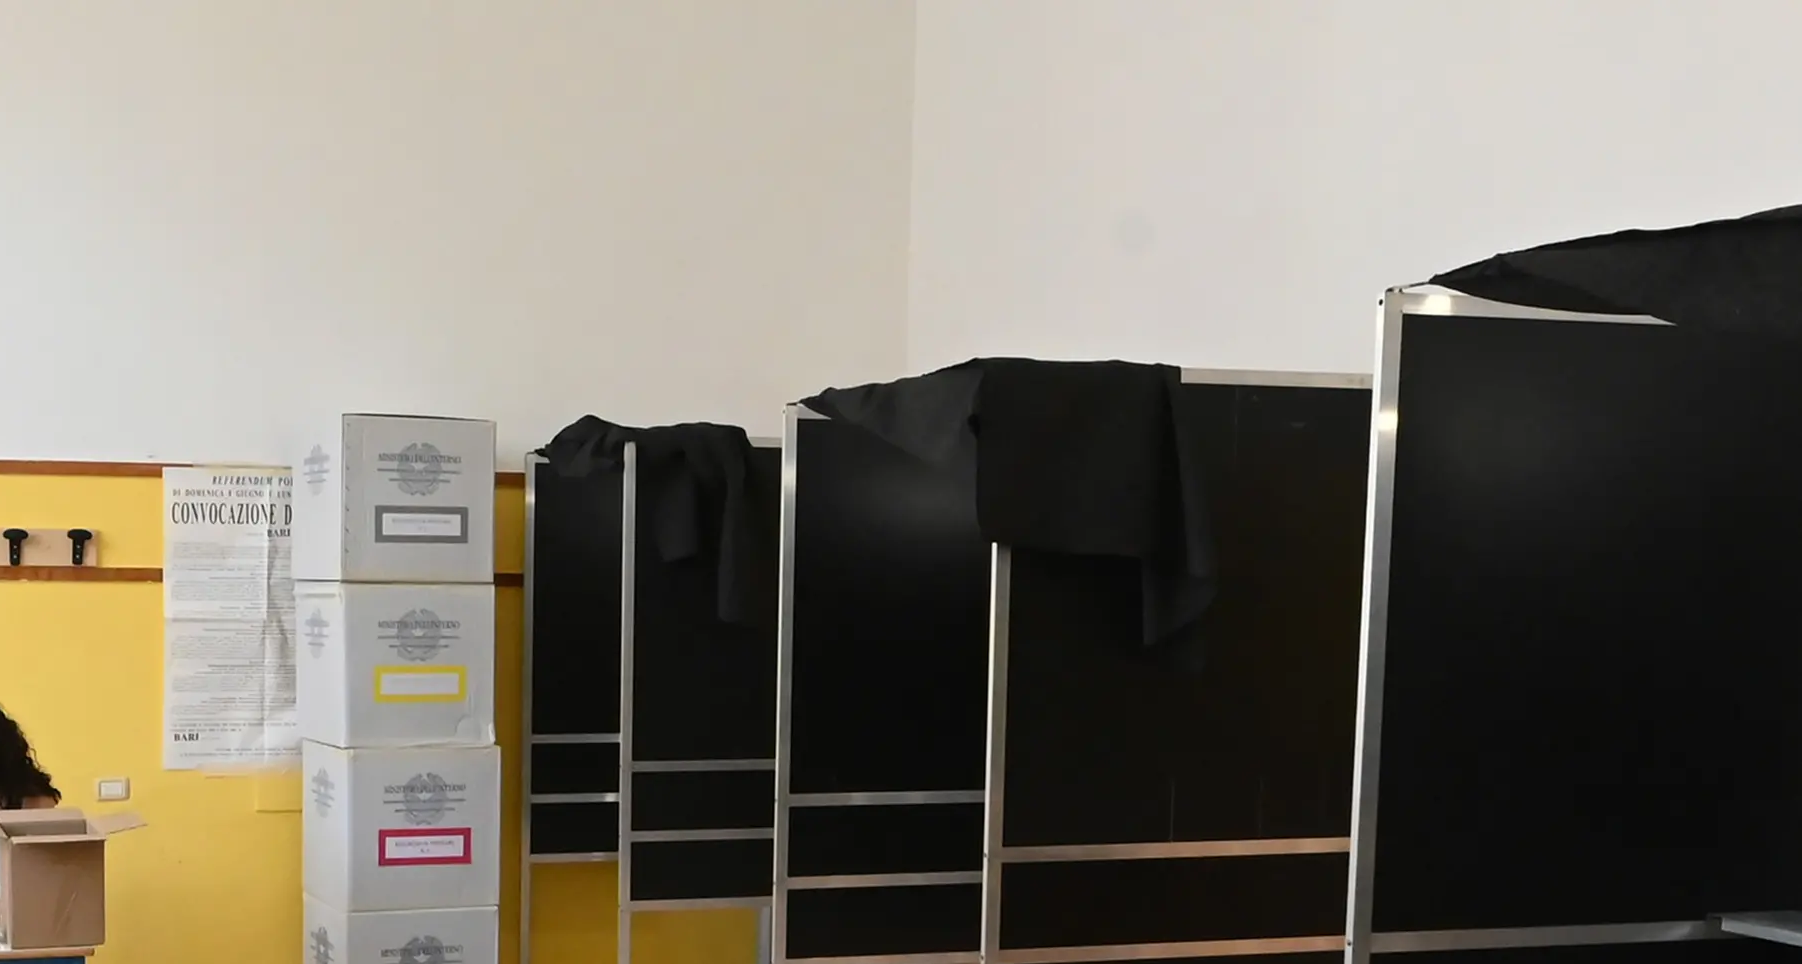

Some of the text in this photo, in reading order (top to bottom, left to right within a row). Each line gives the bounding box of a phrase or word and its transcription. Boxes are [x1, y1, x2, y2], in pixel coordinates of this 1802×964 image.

[212, 475, 273, 486] REFERENDUM
[171, 502, 277, 525] CONVOCAZIONE
[267, 528, 291, 537] BARI
[173, 732, 199, 742] BARI
